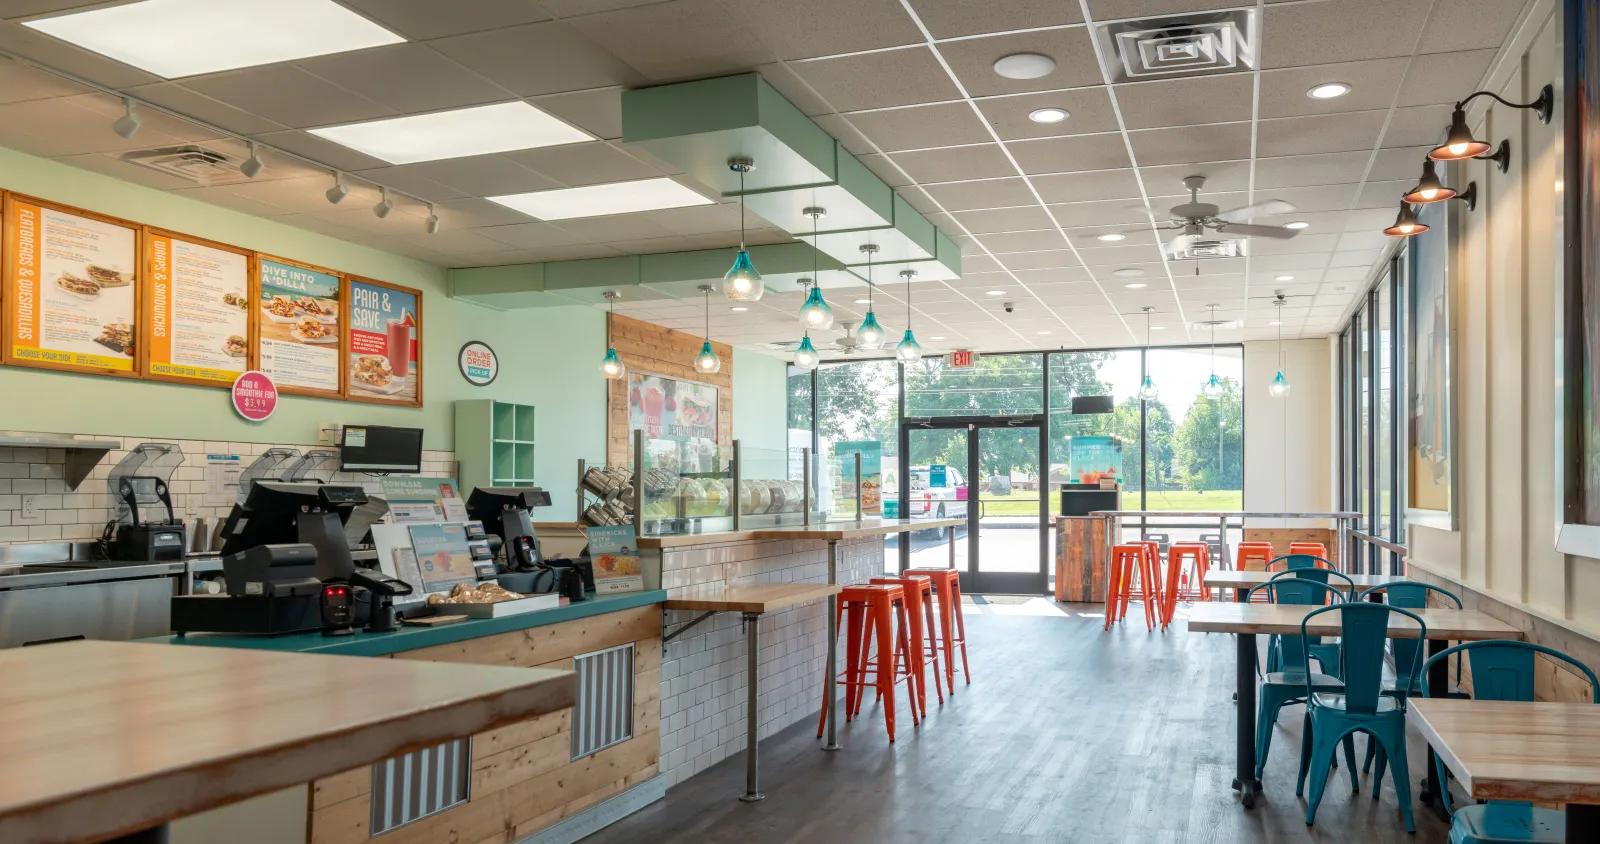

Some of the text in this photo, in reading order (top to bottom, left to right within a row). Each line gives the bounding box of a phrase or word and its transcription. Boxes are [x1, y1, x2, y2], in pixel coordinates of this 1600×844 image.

[19, 209, 34, 267] FLATBREADS
[154, 240, 166, 272] WRAPS
[262, 264, 315, 284] DIVE INTO
[262, 274, 271, 284] A
[353, 287, 392, 313] PAIR &
[18, 279, 34, 340] QUESADILLAS
[154, 283, 166, 338] SANDWICHES
[353, 307, 381, 330] SAVE
[16, 348, 41, 359] CHOOSE
[42, 350, 58, 362] YOUR
[58, 352, 72, 362] SIDE
[466, 349, 491, 360] ONLINE
[953, 351, 972, 366] EXIT
[466, 357, 490, 368] ORDER
[152, 364, 172, 374] CHOOSE
[186, 367, 196, 376] SIDE
[242, 380, 253, 388] ADD
[236, 388, 275, 399] SMOOTHIE FOR
[244, 398, 266, 408] $3.99
[383, 480, 423, 488] DOWNLOAD
[406, 488, 439, 496] SUNSHINE
